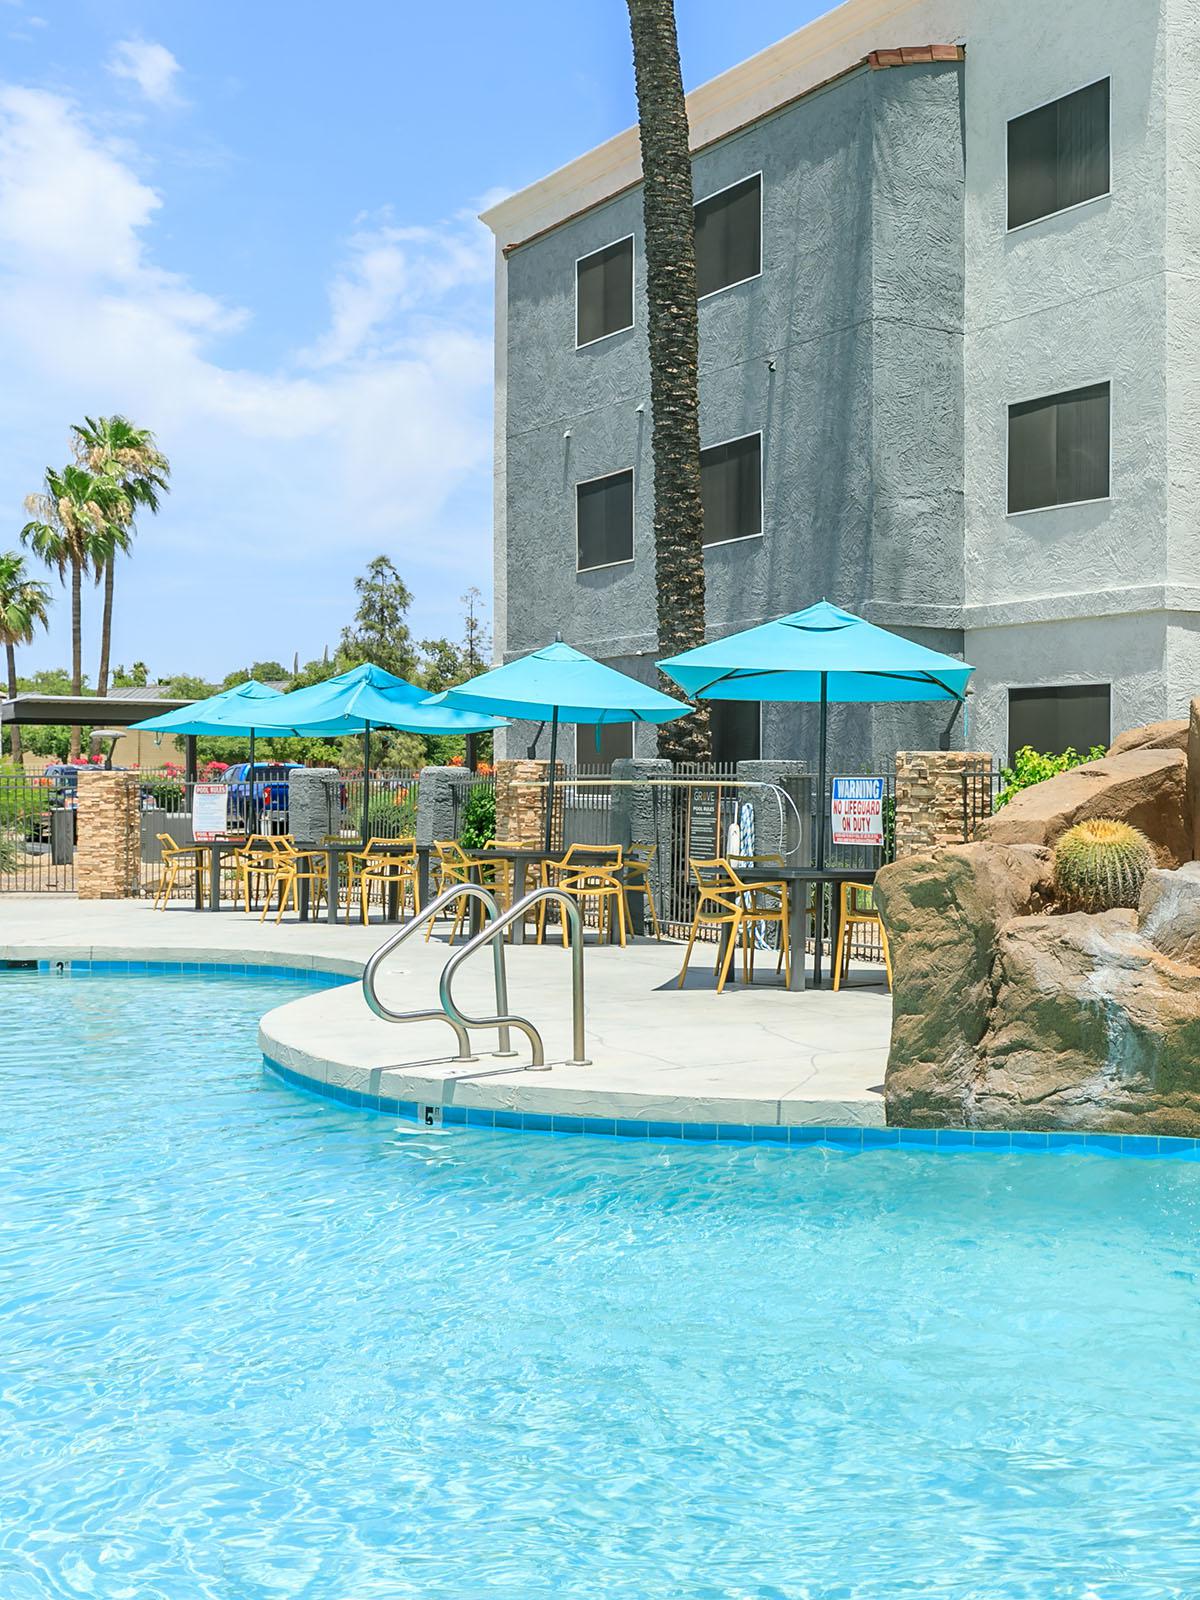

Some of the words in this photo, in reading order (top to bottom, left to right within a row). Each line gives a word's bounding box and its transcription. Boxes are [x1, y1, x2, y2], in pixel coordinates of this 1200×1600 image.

[211, 786, 226, 794] RULES
[837, 780, 880, 799] WARNING
[833, 800, 842, 815] NO
[844, 801, 880, 815] LIFEGUARD
[842, 817, 851, 831] ON
[853, 817, 870, 832] DUTY
[425, 1106, 434, 1125] 5
